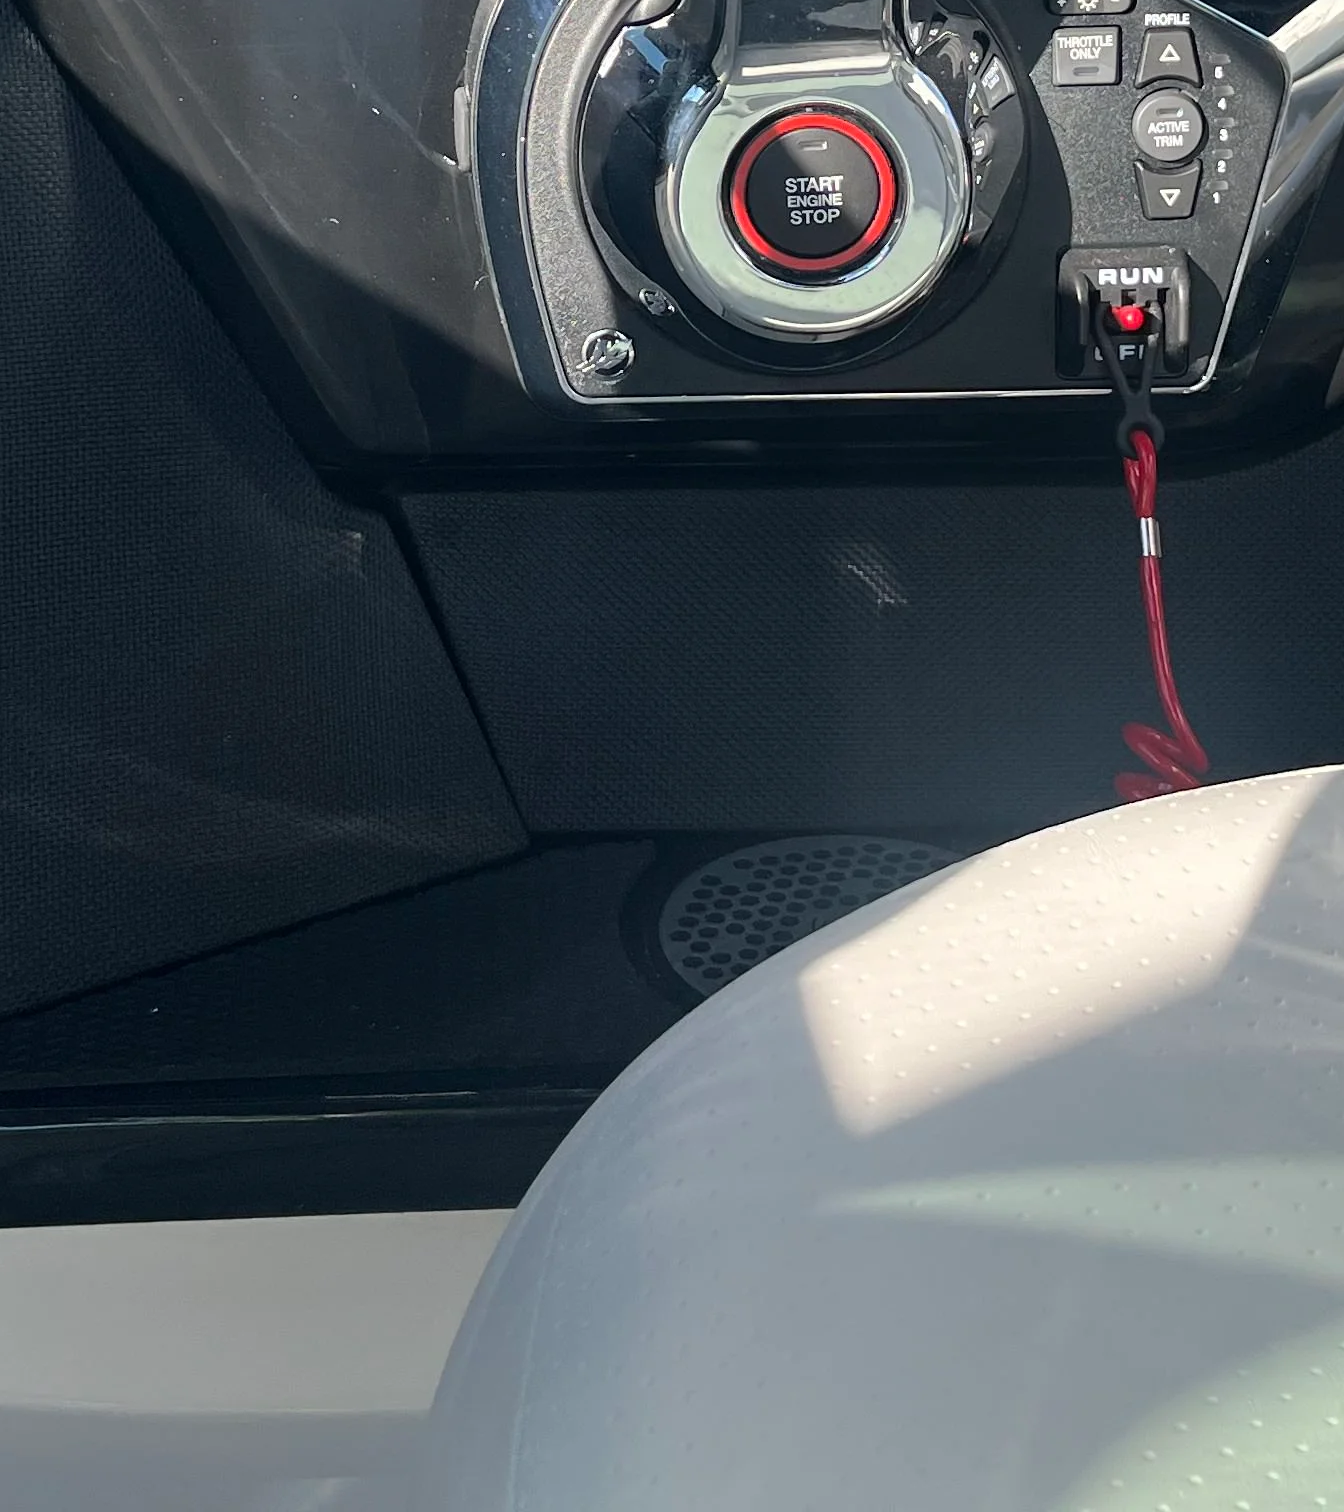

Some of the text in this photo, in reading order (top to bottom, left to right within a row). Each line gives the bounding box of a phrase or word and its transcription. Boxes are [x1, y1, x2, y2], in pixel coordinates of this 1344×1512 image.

[1144, 13, 1191, 26] PROFILE
[1057, 35, 1114, 48] THROTTLE
[1069, 46, 1102, 60] ONLY
[1213, 66, 1223, 79] 5
[1217, 98, 1227, 111] 4
[1147, 121, 1190, 134] ACTIVE
[1153, 135, 1184, 148] TRIM
[1219, 129, 1229, 141] 3
[1217, 160, 1227, 173] 2
[784, 175, 844, 193] START
[787, 193, 843, 208] ENGINE
[1212, 191, 1222, 204] 1
[789, 208, 841, 225] STOP
[1098, 267, 1163, 286] RUN
